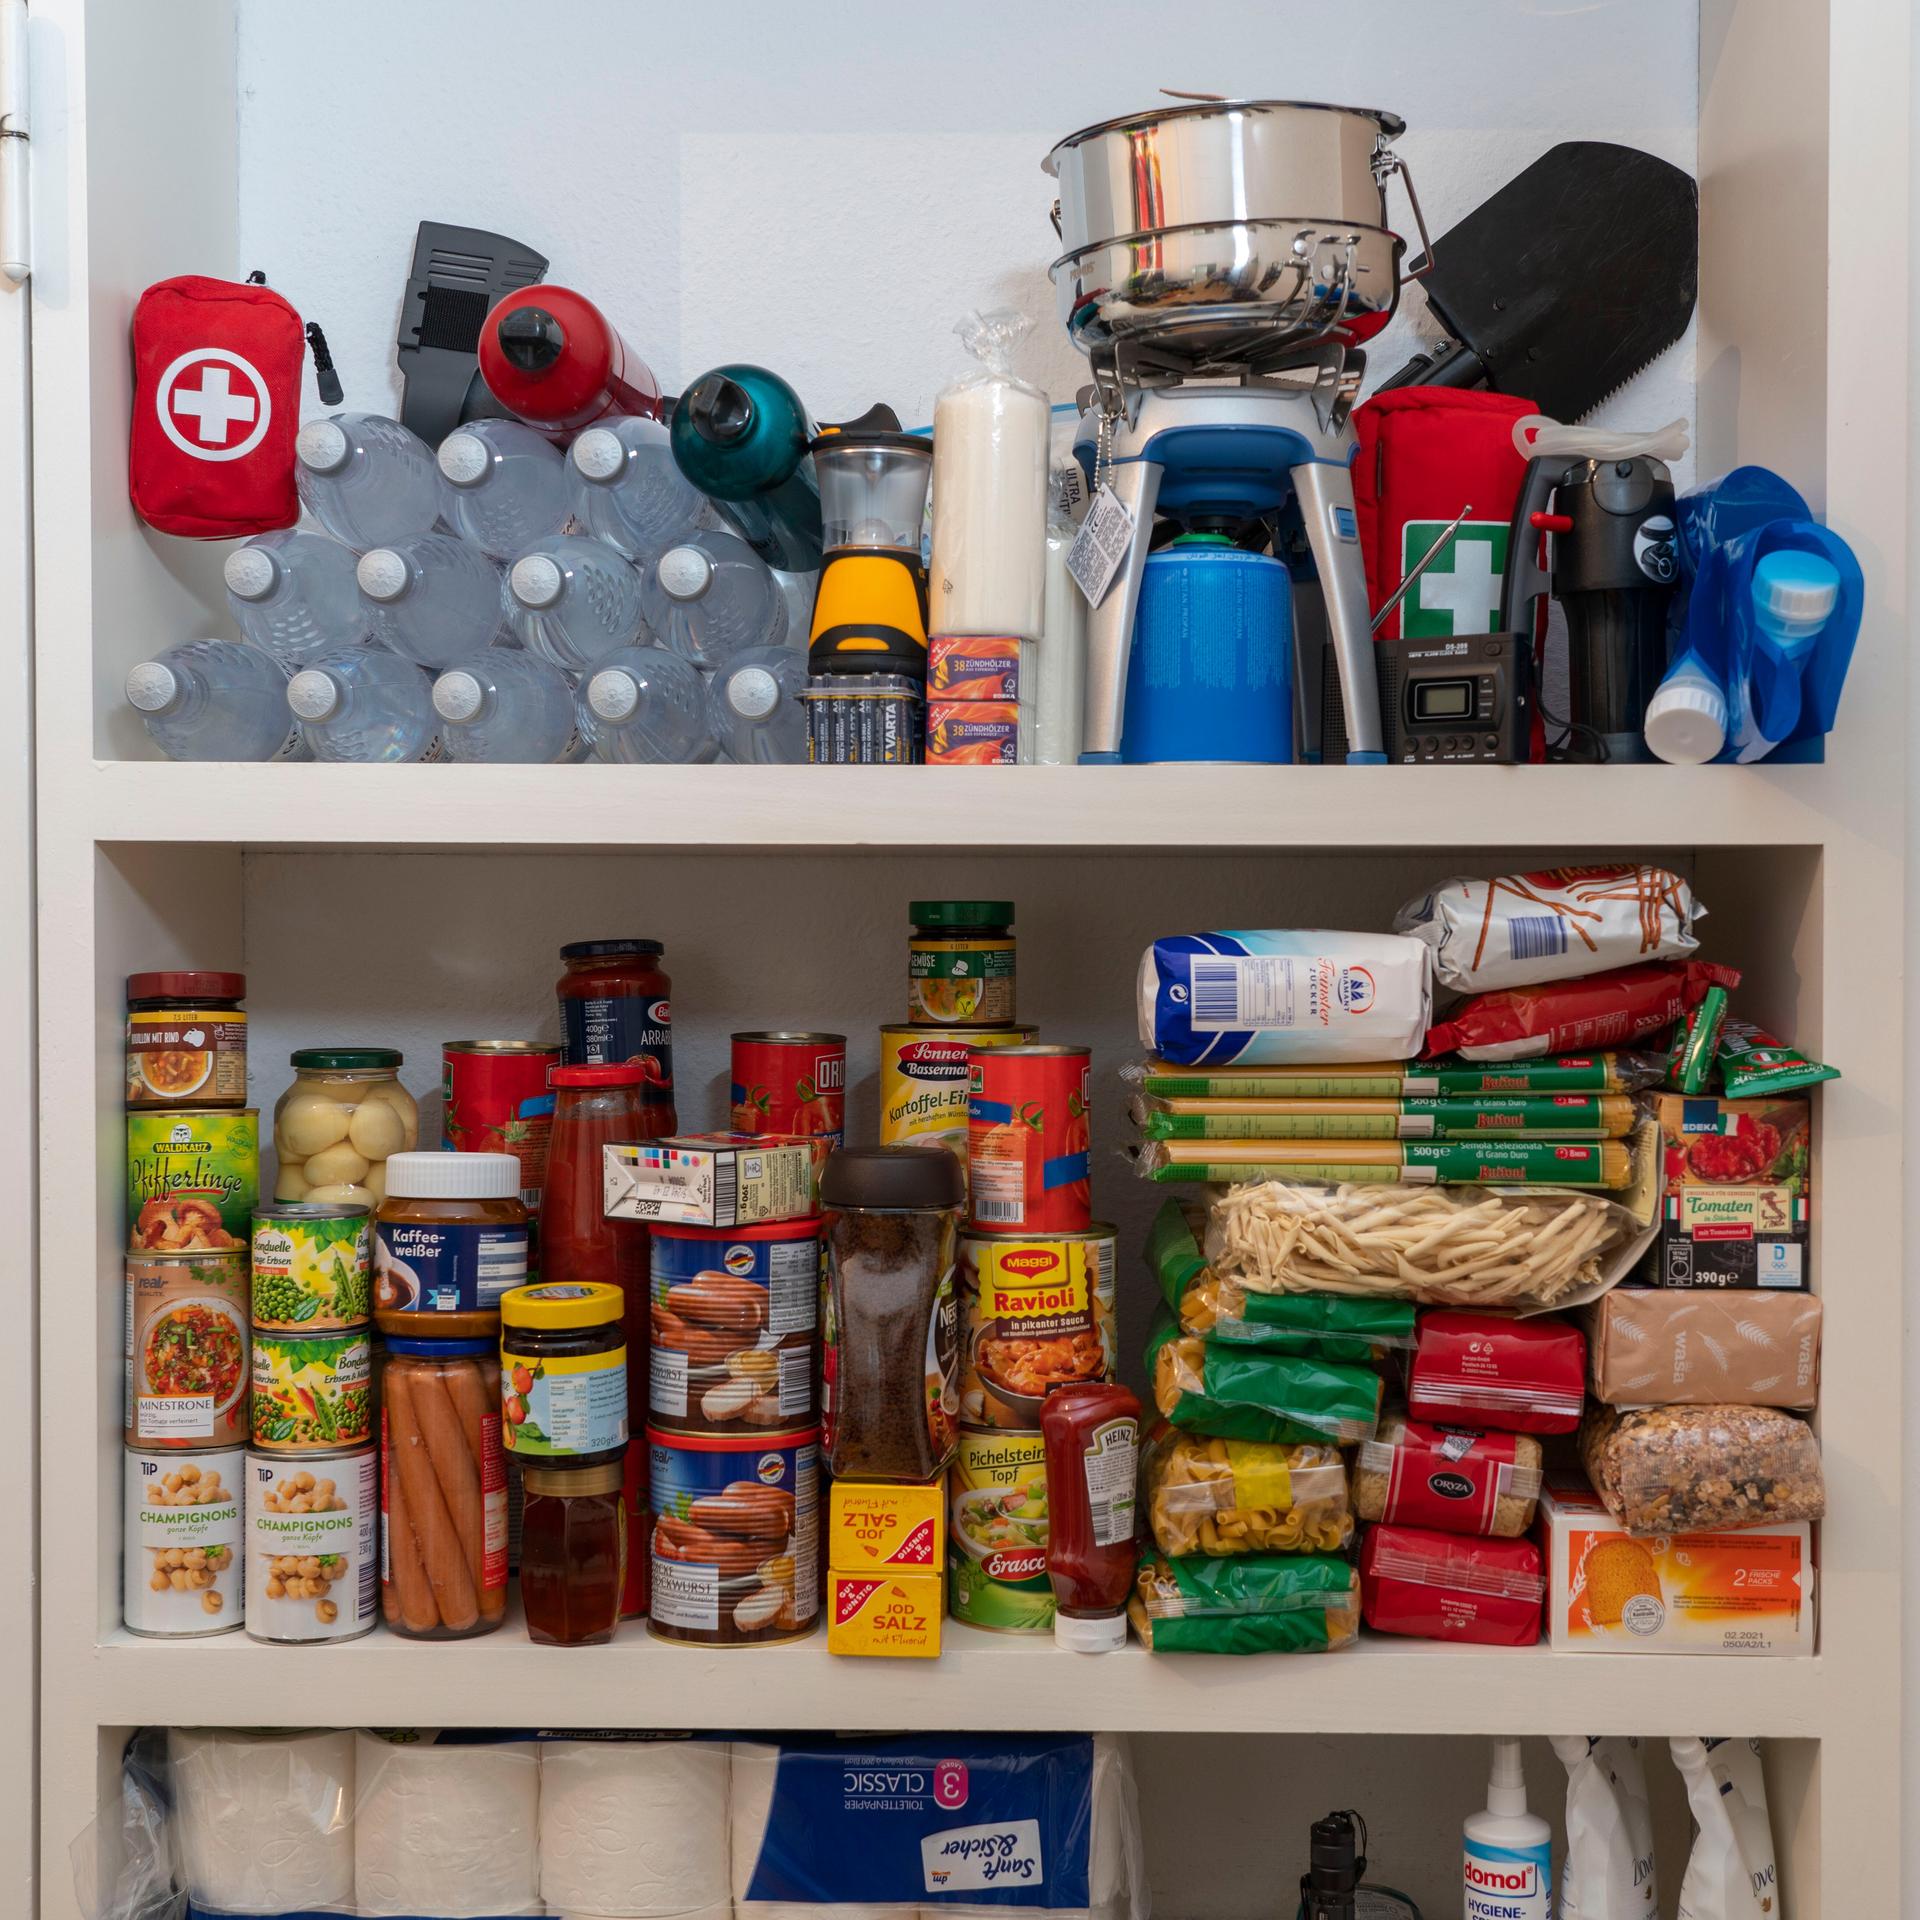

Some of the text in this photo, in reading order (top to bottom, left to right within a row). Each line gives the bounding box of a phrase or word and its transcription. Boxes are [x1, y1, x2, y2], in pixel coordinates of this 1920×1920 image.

[954, 659, 1011, 671] 38 ZÜNDHÖLZER
[816, 700, 823, 713] AA
[859, 700, 865, 713] AA
[885, 703, 896, 749] VARTA
[952, 724, 1010, 736] 38 ZÜNDHÖLZER
[1309, 967, 1317, 1016] ZUCKER
[1317, 958, 1336, 1026] Feinster
[1342, 969, 1350, 1013] DIAMANT
[152, 1031, 179, 1043] MIT RIND
[820, 1060, 845, 1088] ORO
[1481, 1076, 1530, 1090] Buitoni
[1483, 1099, 1506, 1107] Grano
[1507, 1099, 1527, 1107] Duro
[918, 1112, 946, 1124] herzhaften
[1477, 1113, 1525, 1128] Buitoni
[1682, 1123, 1718, 1131] EDEKA
[156, 1143, 208, 1153] WALDKAUZ
[1460, 1142, 1542, 1151] Semola Selezionata
[1476, 1151, 1528, 1159] di Grano Duro
[1480, 1165, 1526, 1180] Buitoni
[132, 1157, 242, 1204] Pfifferlinge
[1686, 1197, 1753, 1214] Tomaten
[393, 1229, 446, 1243] Kaffee-
[1710, 1228, 1748, 1236] Tomatensaft
[395, 1244, 442, 1258] weißer
[267, 1256, 291, 1265] Erbsen
[1007, 1256, 1053, 1268] Maggi
[1695, 1271, 1726, 1286] 390 g
[994, 1287, 1075, 1312] Ravioli
[1022, 1316, 1084, 1331] pikanter Sauce
[1673, 1331, 1687, 1384] wasa
[1796, 1334, 1811, 1387] wasa
[325, 1375, 350, 1384] Erbsen
[140, 1399, 211, 1411] MINESTRONE
[1105, 1429, 1131, 1446] HEINZ
[990, 1467, 1019, 1484] Topf
[1433, 1478, 1468, 1493] ORYZA
[843, 1498, 879, 1509] Fluorid
[140, 1507, 237, 1524] CHAMPIGNONS
[844, 1513, 897, 1527] SALZ
[167, 1524, 208, 1535] ganze Köpfe
[257, 1517, 353, 1532] CHAMPIGNONS
[281, 1533, 322, 1543] ganze Köpfe
[856, 1529, 885, 1539] JOD
[916, 1545, 932, 1562] GUT
[988, 1554, 1046, 1576] Erasco
[1733, 1568, 1747, 1586] 2
[839, 1582, 855, 1599] GUT
[886, 1604, 915, 1614] JOD
[873, 1616, 927, 1631] SALZ
[892, 1635, 927, 1646] Fluorid
[1724, 1631, 1763, 1640] 02.2021
[843, 1773, 925, 1793] CLASSIC
[943, 1772, 960, 1799] 3
[844, 1799, 924, 1811] TOILETTENPAPIER
[982, 1855, 1035, 1880] Sanft
[933, 1875, 948, 1885] dm
[1464, 1862, 1527, 1889] domol
[1468, 1898, 1526, 1919] HYGIENE-
